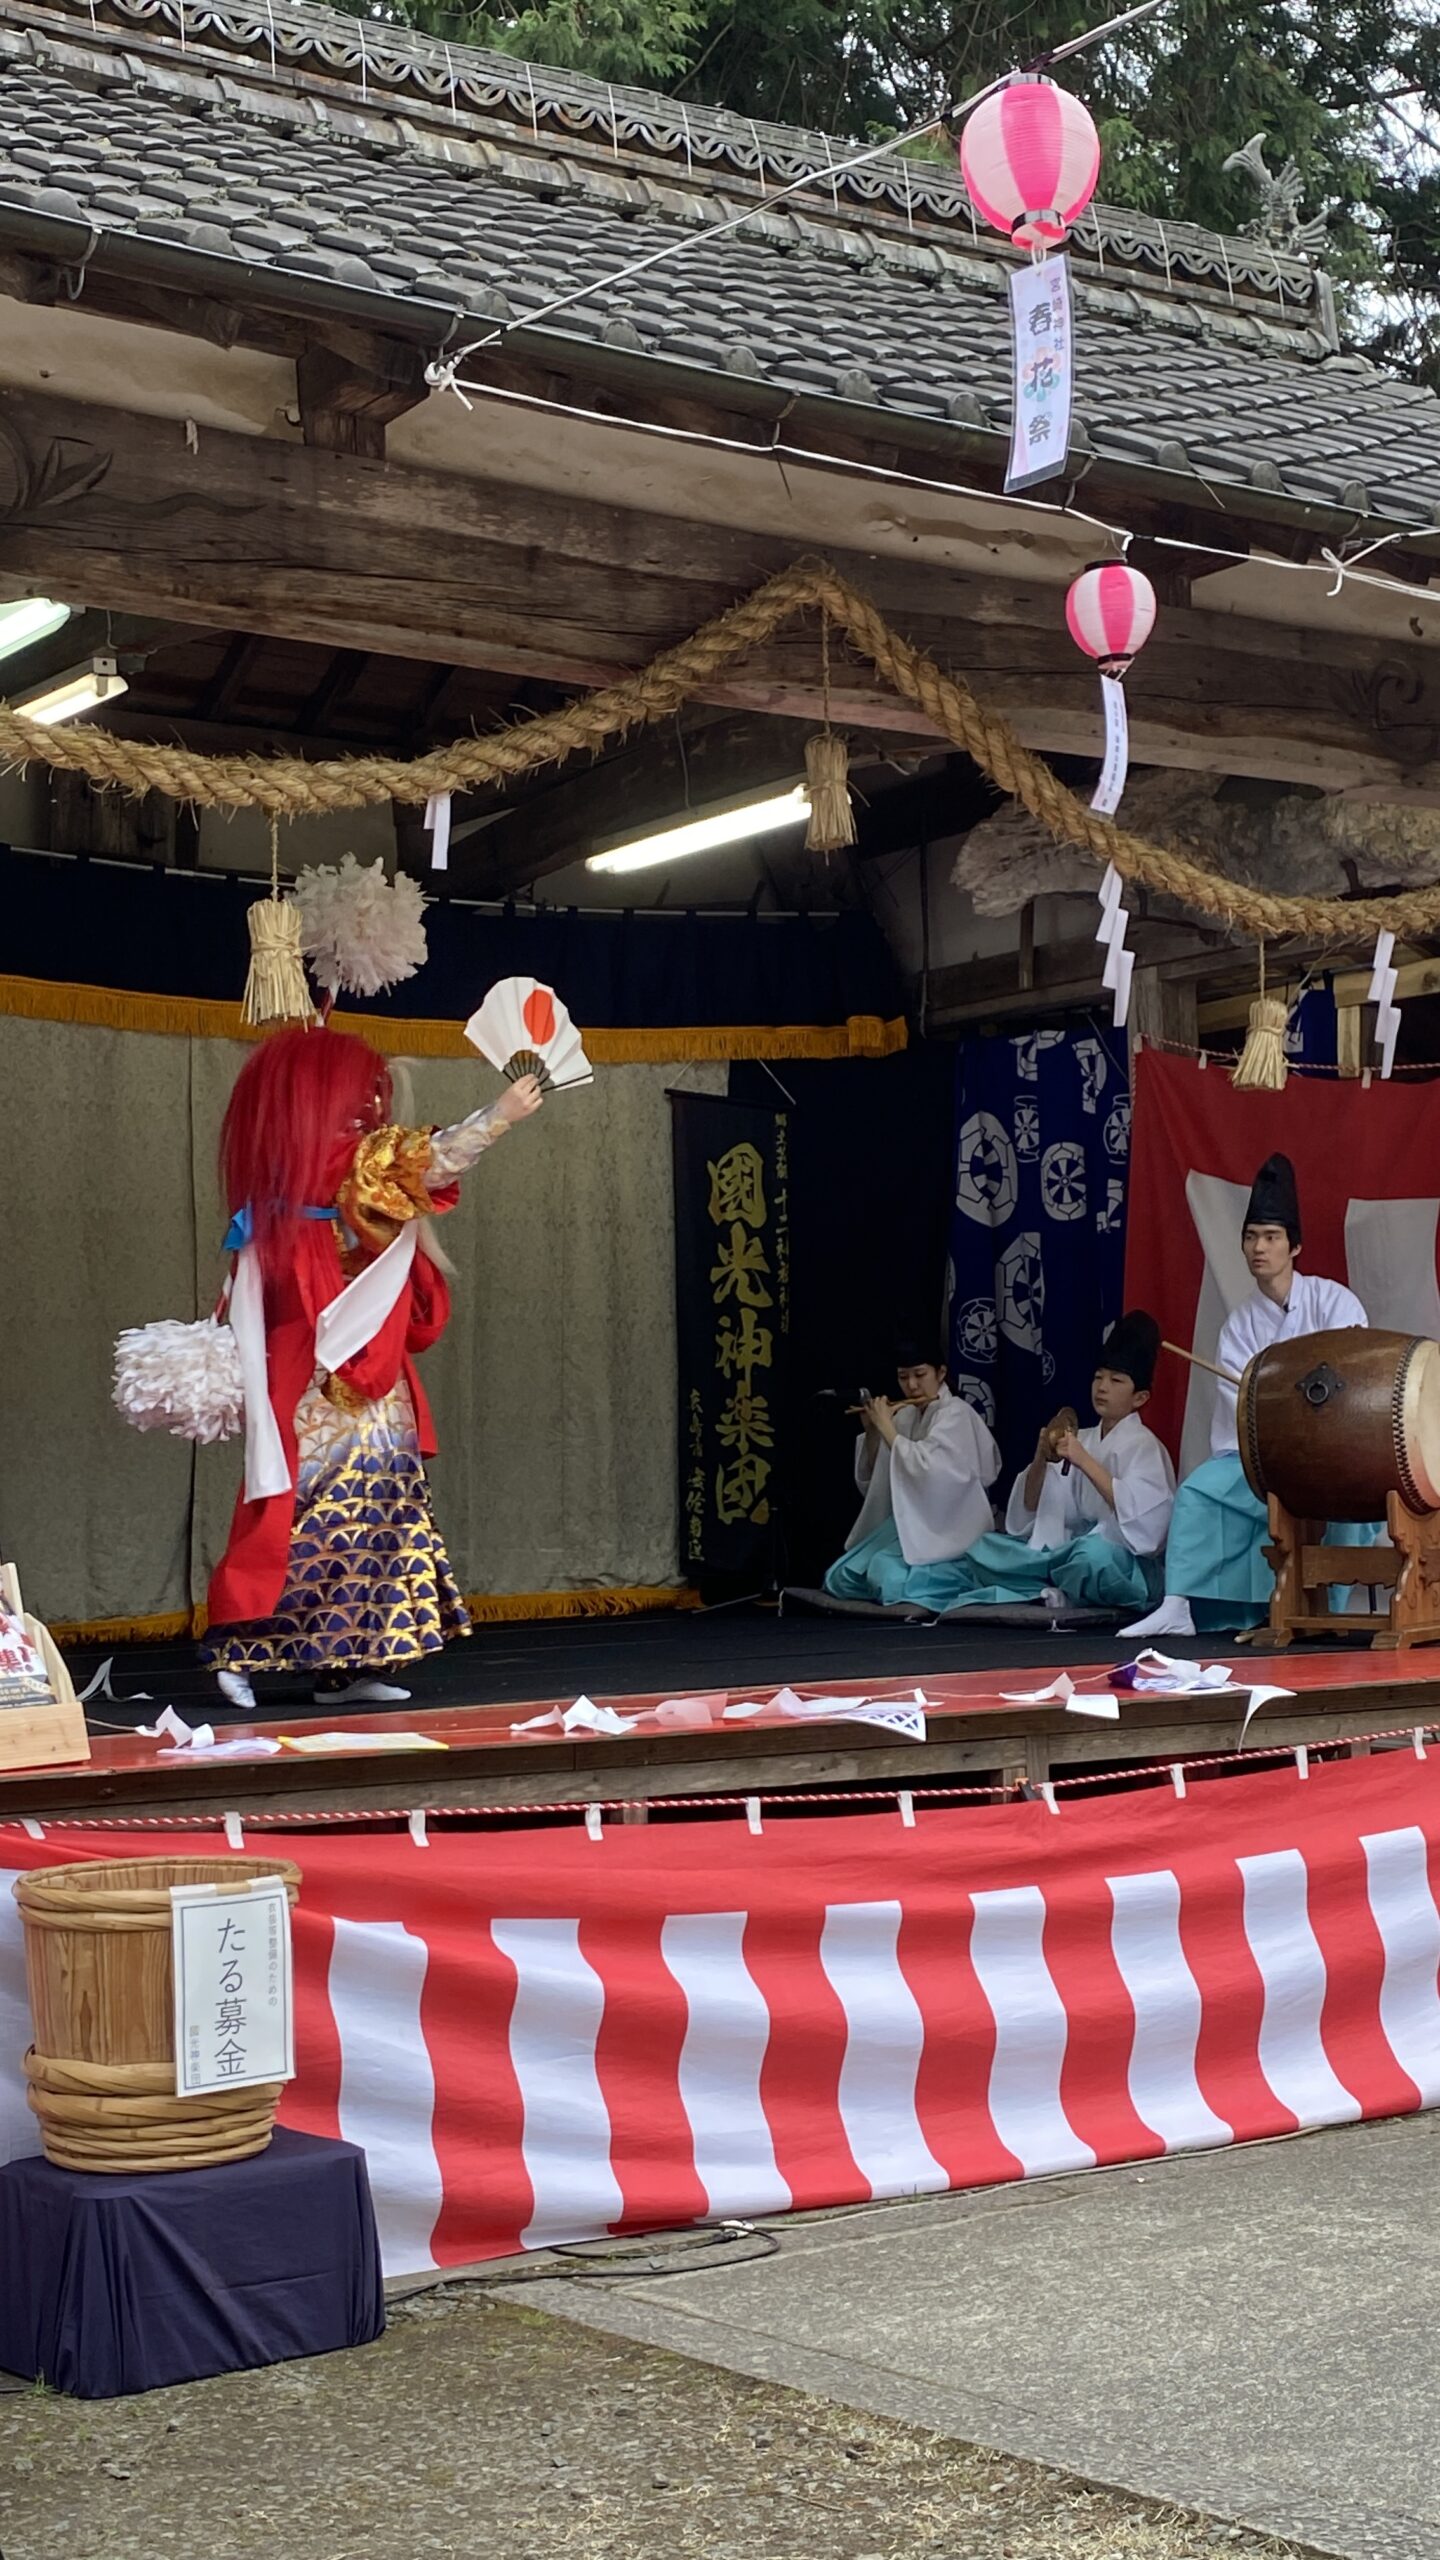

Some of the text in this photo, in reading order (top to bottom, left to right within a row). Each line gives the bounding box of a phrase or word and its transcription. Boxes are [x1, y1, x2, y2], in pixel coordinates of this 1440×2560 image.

[1028, 302, 1053, 446] 春花祭
[213, 1918, 248, 2078] たる募金
